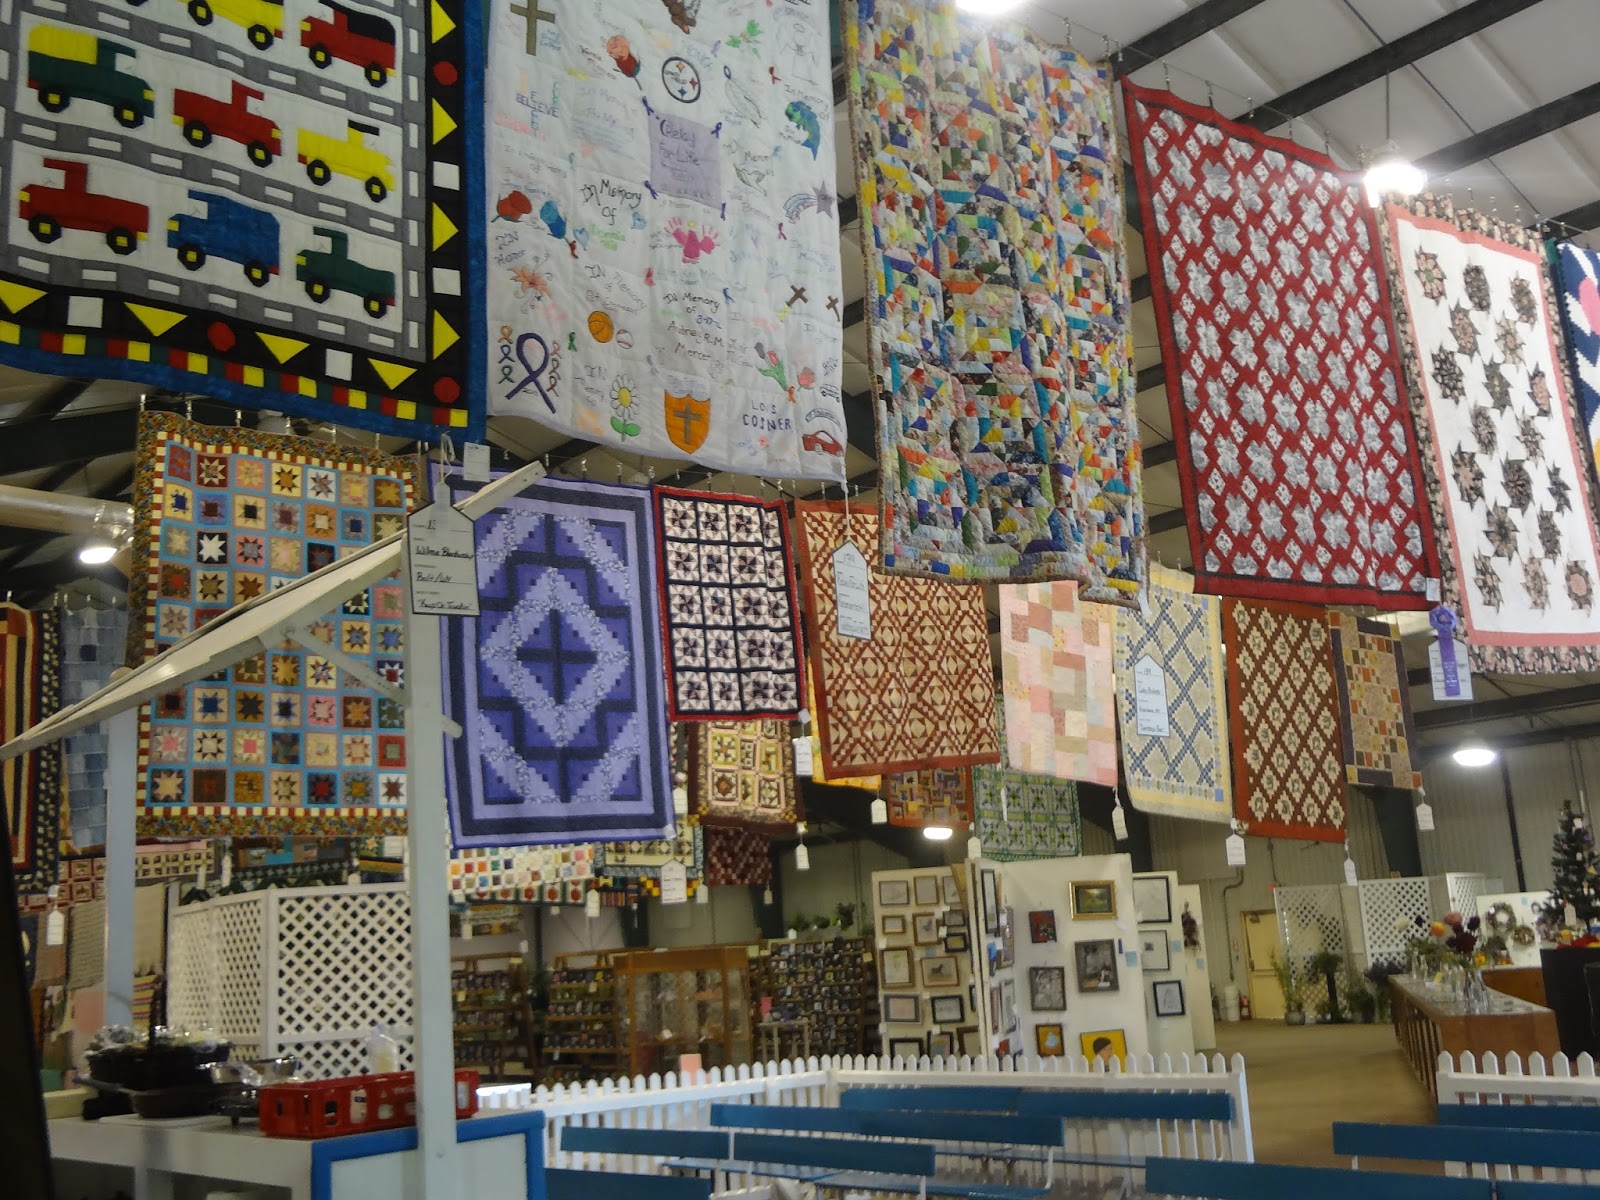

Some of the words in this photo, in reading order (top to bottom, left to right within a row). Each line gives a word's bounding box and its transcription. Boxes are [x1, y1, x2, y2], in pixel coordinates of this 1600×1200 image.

[600, 179, 642, 210] Memory
[682, 292, 720, 314] Memory
[742, 413, 792, 432] COSNER
